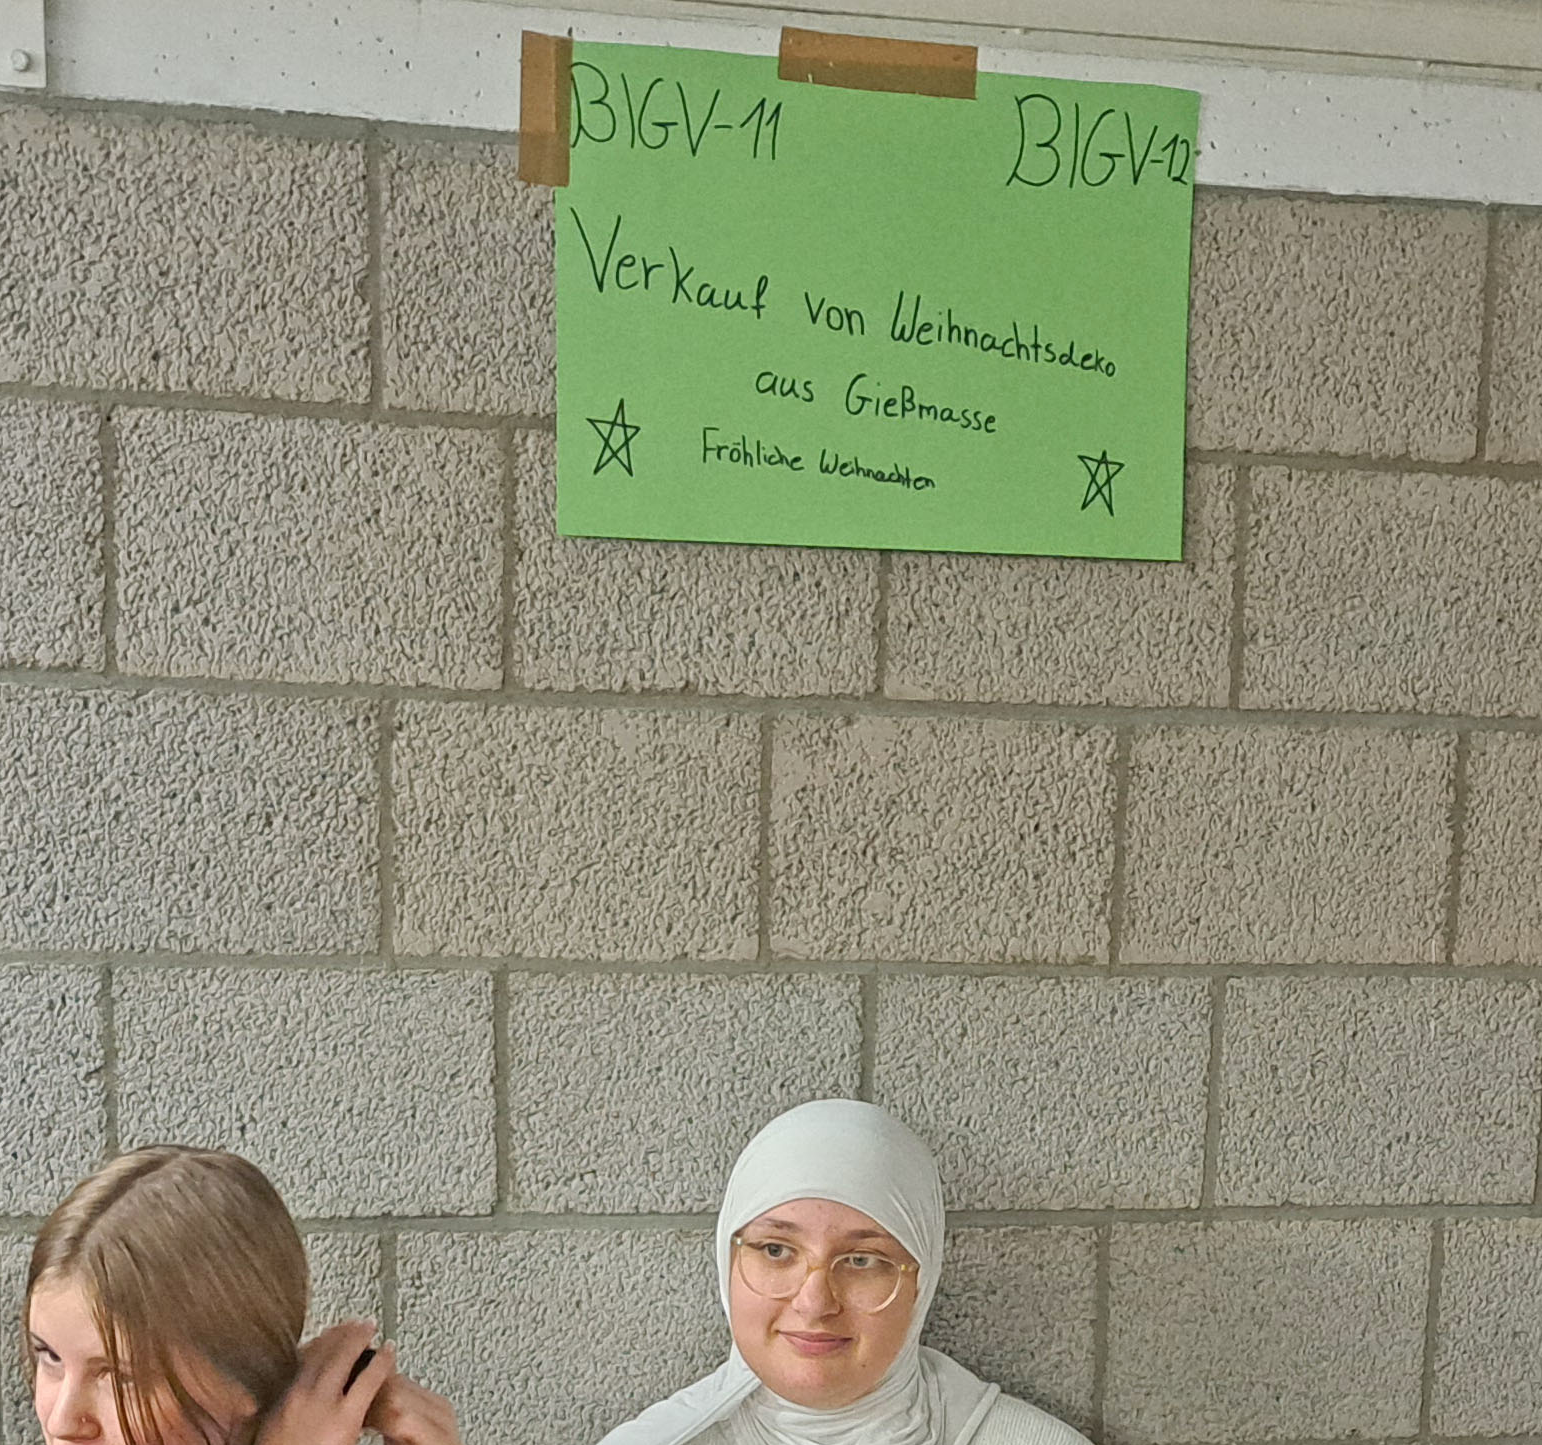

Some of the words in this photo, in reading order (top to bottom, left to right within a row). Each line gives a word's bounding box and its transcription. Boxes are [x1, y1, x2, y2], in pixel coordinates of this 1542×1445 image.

[569, 61, 784, 161] BIGV-11
[1005, 94, 1192, 189] BIGV-12
[570, 207, 769, 319] Verkauf
[804, 292, 865, 337] von
[890, 291, 1117, 378] Weihnachtsdeko
[702, 427, 805, 472] Fröhliche
[755, 370, 815, 403] aus
[846, 374, 998, 434] Gießmasse
